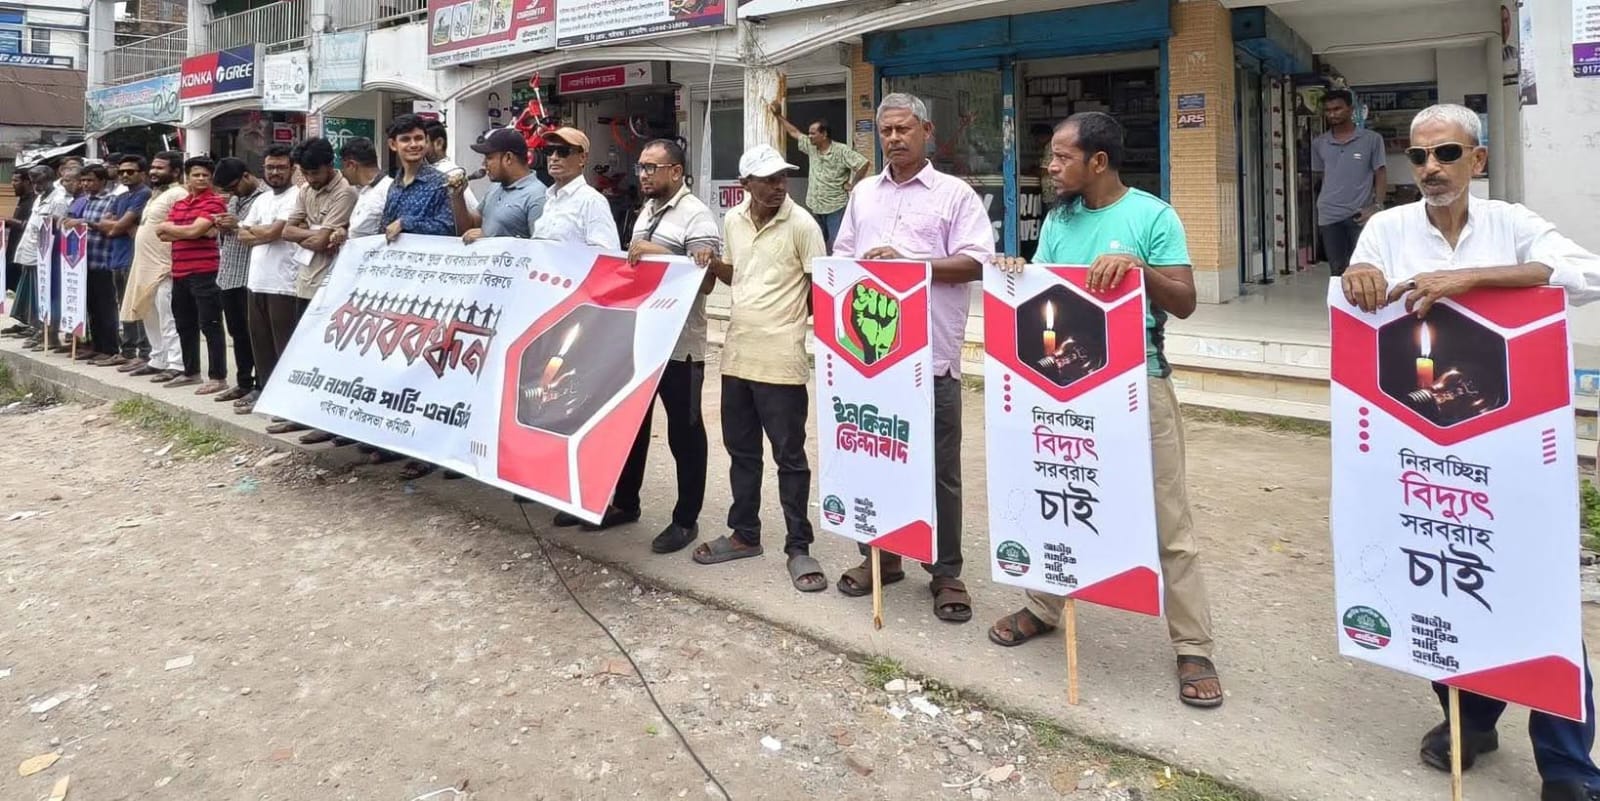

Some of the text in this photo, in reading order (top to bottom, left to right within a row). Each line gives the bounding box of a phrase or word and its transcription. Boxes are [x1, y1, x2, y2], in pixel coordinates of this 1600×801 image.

[182, 62, 254, 88] KONKA GREE
[492, 251, 515, 268] ক্ষতি
[417, 270, 436, 284] নতুন
[481, 269, 515, 289] বিরুদ্ধে
[324, 299, 498, 384] মানববন্ধন
[288, 367, 325, 392] জাতীয়
[324, 377, 377, 406] নাগরিক
[319, 401, 347, 418] গাইবান্ধা
[348, 407, 384, 428] পৌরসভা
[832, 396, 910, 443] ইনকিলাব
[1032, 406, 1096, 433] নিরবচ্ছিন্ন
[836, 423, 909, 464] জিন্দাবাদ
[1032, 425, 1099, 464] বিদ্যুৎ
[1033, 460, 1100, 487] সরবরাহ
[1398, 447, 1492, 486] নিরবচ্ছিন্ন
[1034, 482, 1100, 536] চাই
[1398, 470, 1494, 523] বিদ্যুৎ
[1399, 512, 1495, 553] সরবরাহ
[1399, 543, 1495, 614] চাই
[1411, 613, 1452, 631] জাতীয়
[1411, 624, 1459, 645] নাগরিক
[1412, 637, 1439, 652] পার্টি
[1412, 649, 1460, 670] এনসিপি
